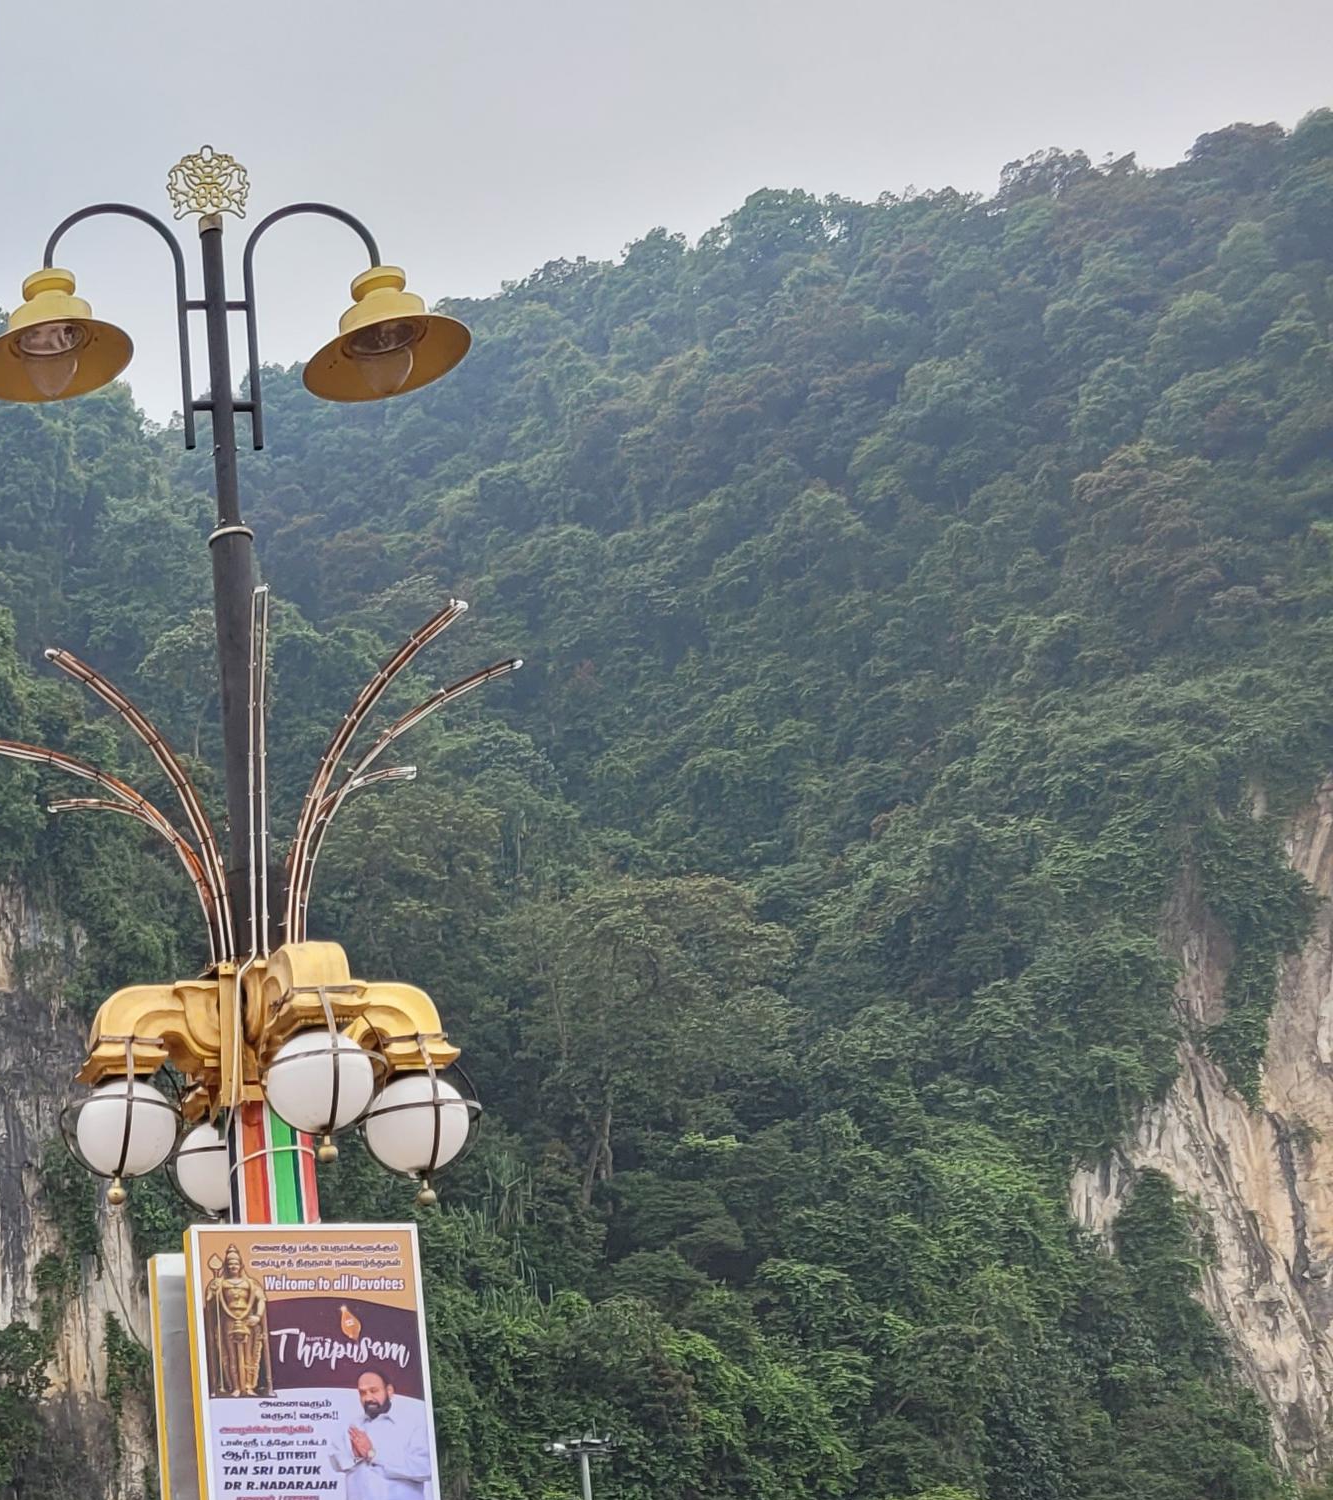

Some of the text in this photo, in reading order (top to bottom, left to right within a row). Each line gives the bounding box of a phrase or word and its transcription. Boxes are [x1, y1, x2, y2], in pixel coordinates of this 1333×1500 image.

[264, 1275, 405, 1291] Welcome to all Devotees
[269, 1328, 410, 1370] Thaipusam
[223, 1465, 321, 1475] TAN SRI DATUK
[224, 1480, 338, 1490] DR R.NADARAJAH
